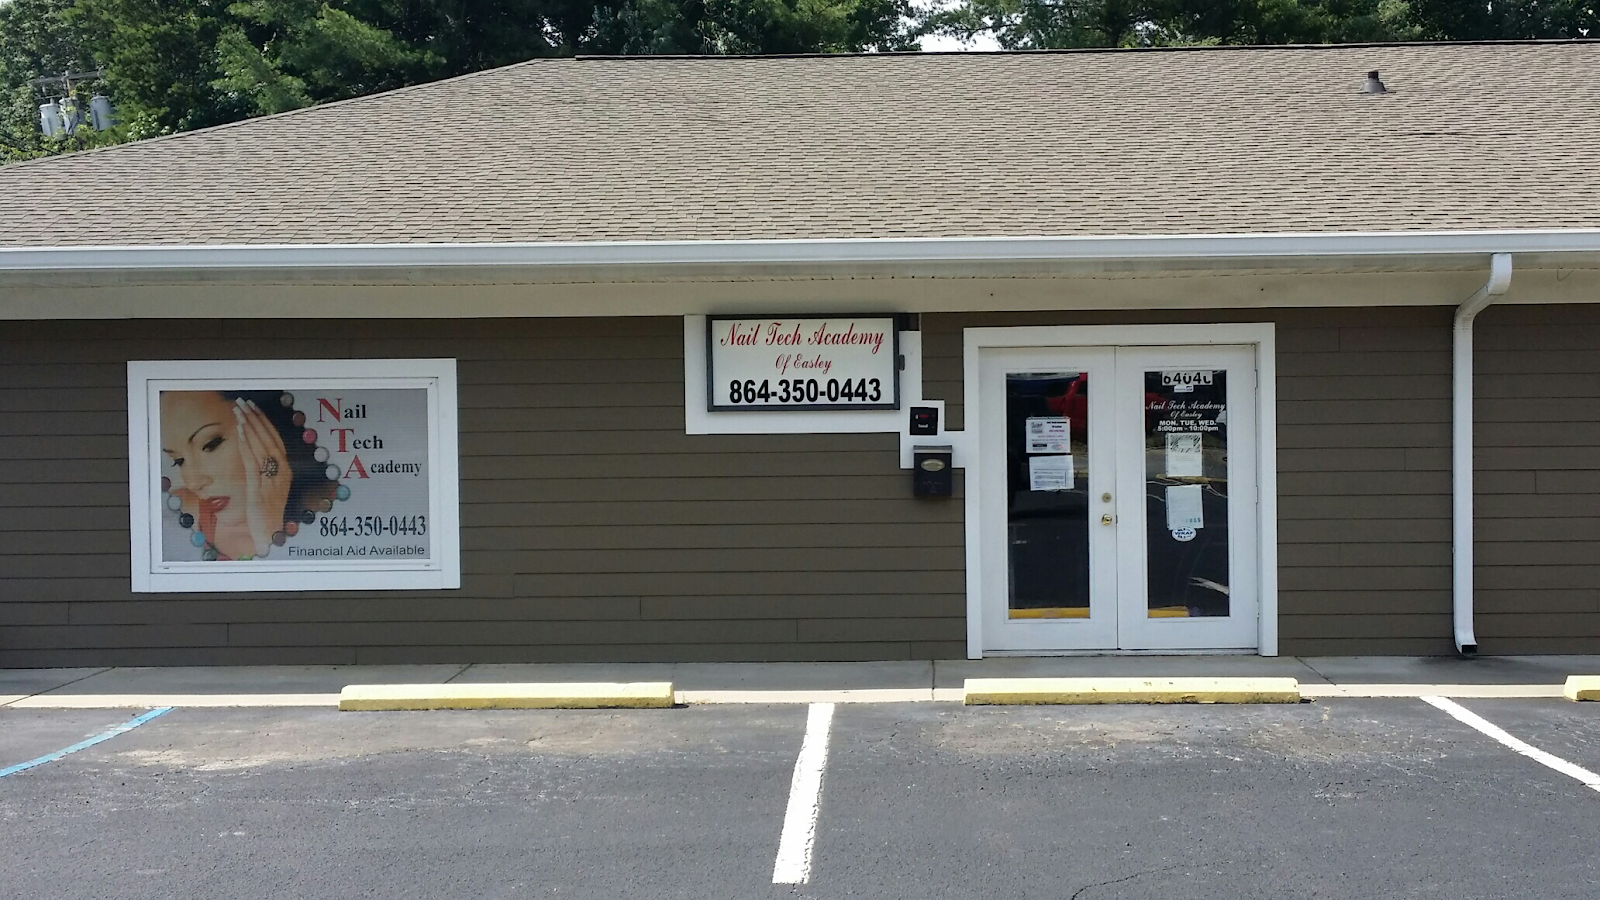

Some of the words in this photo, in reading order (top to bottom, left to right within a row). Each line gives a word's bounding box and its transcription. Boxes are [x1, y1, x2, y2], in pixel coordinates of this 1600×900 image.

[720, 322, 761, 347] Nail
[765, 322, 802, 347] Tech
[807, 321, 885, 354] Academy
[775, 353, 792, 375] Of
[793, 354, 832, 374] Easley
[729, 378, 882, 404] 864-350-0443
[316, 398, 367, 423] Nail
[1145, 401, 1167, 411] Nail
[1167, 401, 1186, 410] Tech
[1187, 401, 1226, 413] Academy
[1180, 411, 1203, 420] Easley
[329, 428, 384, 453] Tech
[343, 455, 422, 479] Academy
[319, 515, 427, 537] 864-350-0443
[288, 546, 344, 557] Financial
[346, 545, 367, 556] Aid
[368, 545, 425, 556] Available
